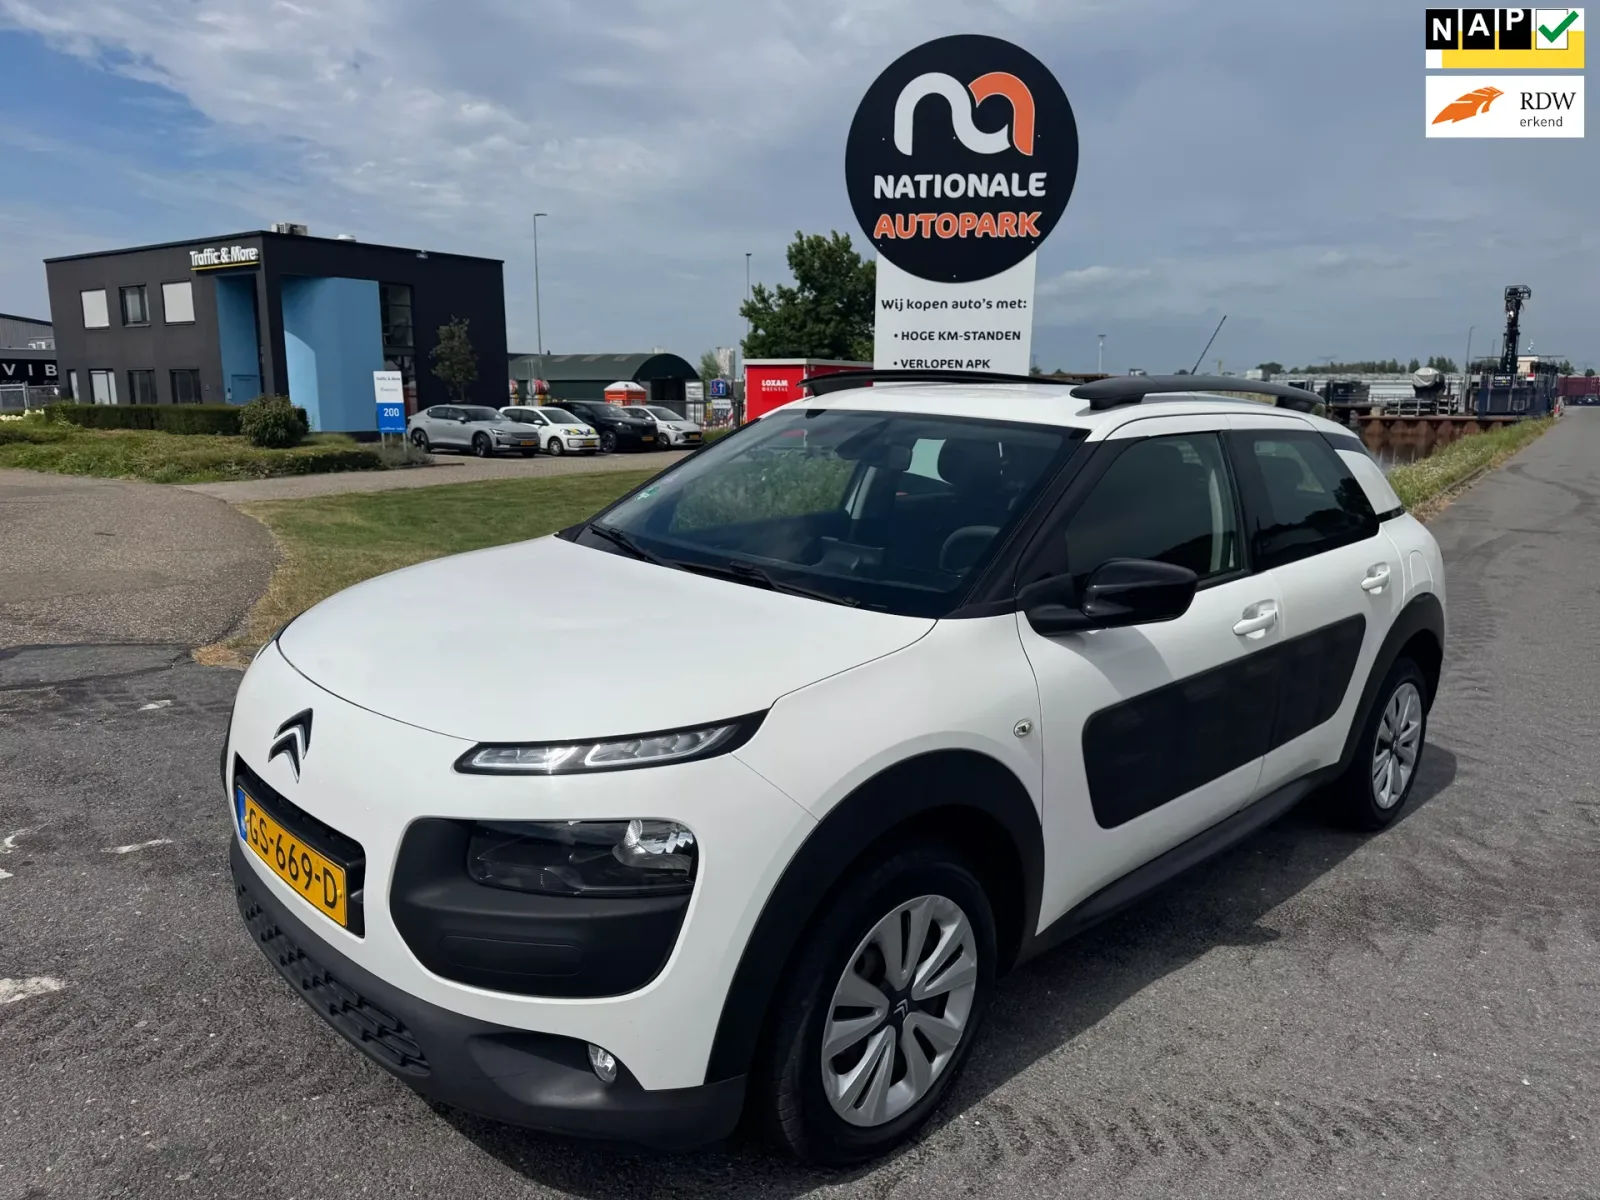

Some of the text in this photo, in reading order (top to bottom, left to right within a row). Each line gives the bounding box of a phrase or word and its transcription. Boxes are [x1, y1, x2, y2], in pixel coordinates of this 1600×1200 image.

[874, 172, 1047, 199] NATIONALE
[873, 212, 1042, 239] AUTOPARK
[189, 246, 259, 266] Traffic & More
[881, 298, 1027, 312] Wij kopen auto's met:
[901, 331, 1021, 341] HOGE KM-STANDEN
[900, 359, 991, 369] VERLOPEN APK
[383, 407, 400, 417] 200
[249, 807, 338, 909] GS-669-D
